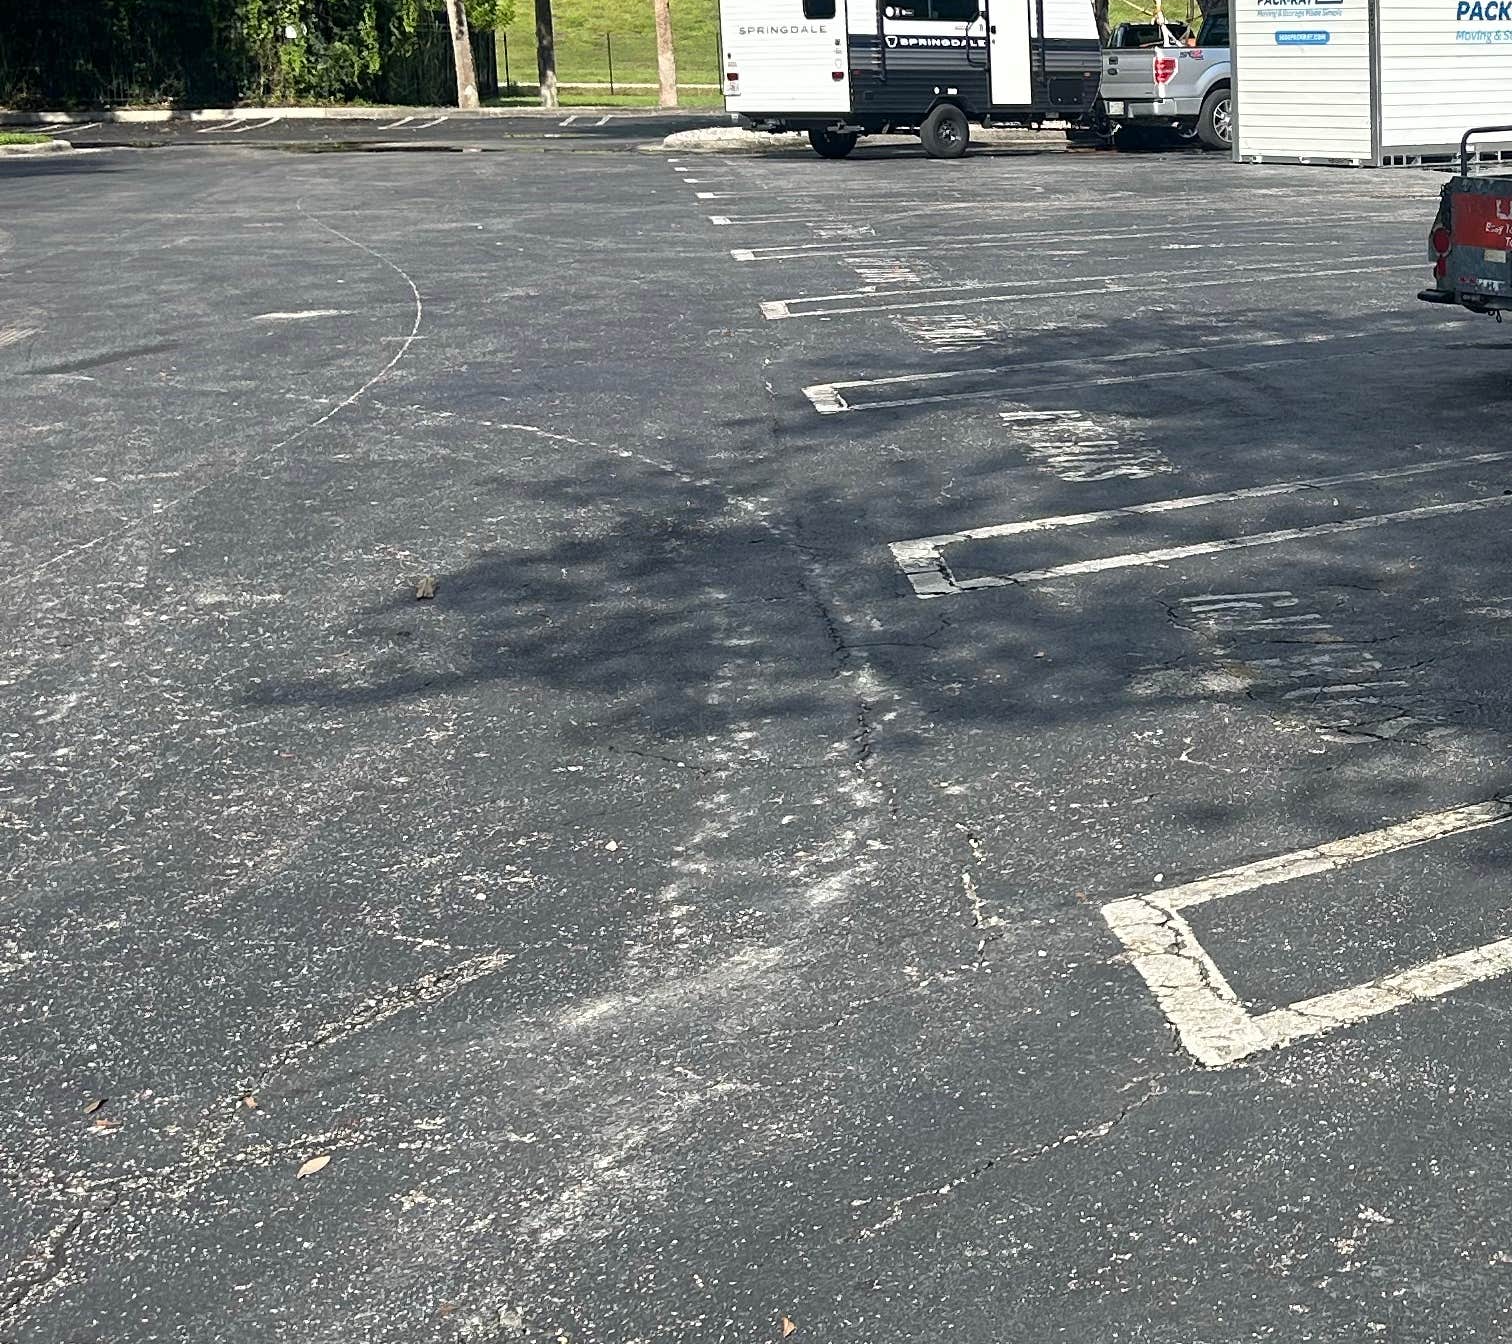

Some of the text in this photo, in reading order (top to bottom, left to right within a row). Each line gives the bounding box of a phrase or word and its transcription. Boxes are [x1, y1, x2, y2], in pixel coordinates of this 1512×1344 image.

[739, 25, 827, 35] SPRINGDALE
[900, 37, 986, 47] SPRINGDALE
[1456, 30, 1491, 44] Moving
[1494, 31, 1501, 41] &
[1485, 222, 1504, 235] Easy
